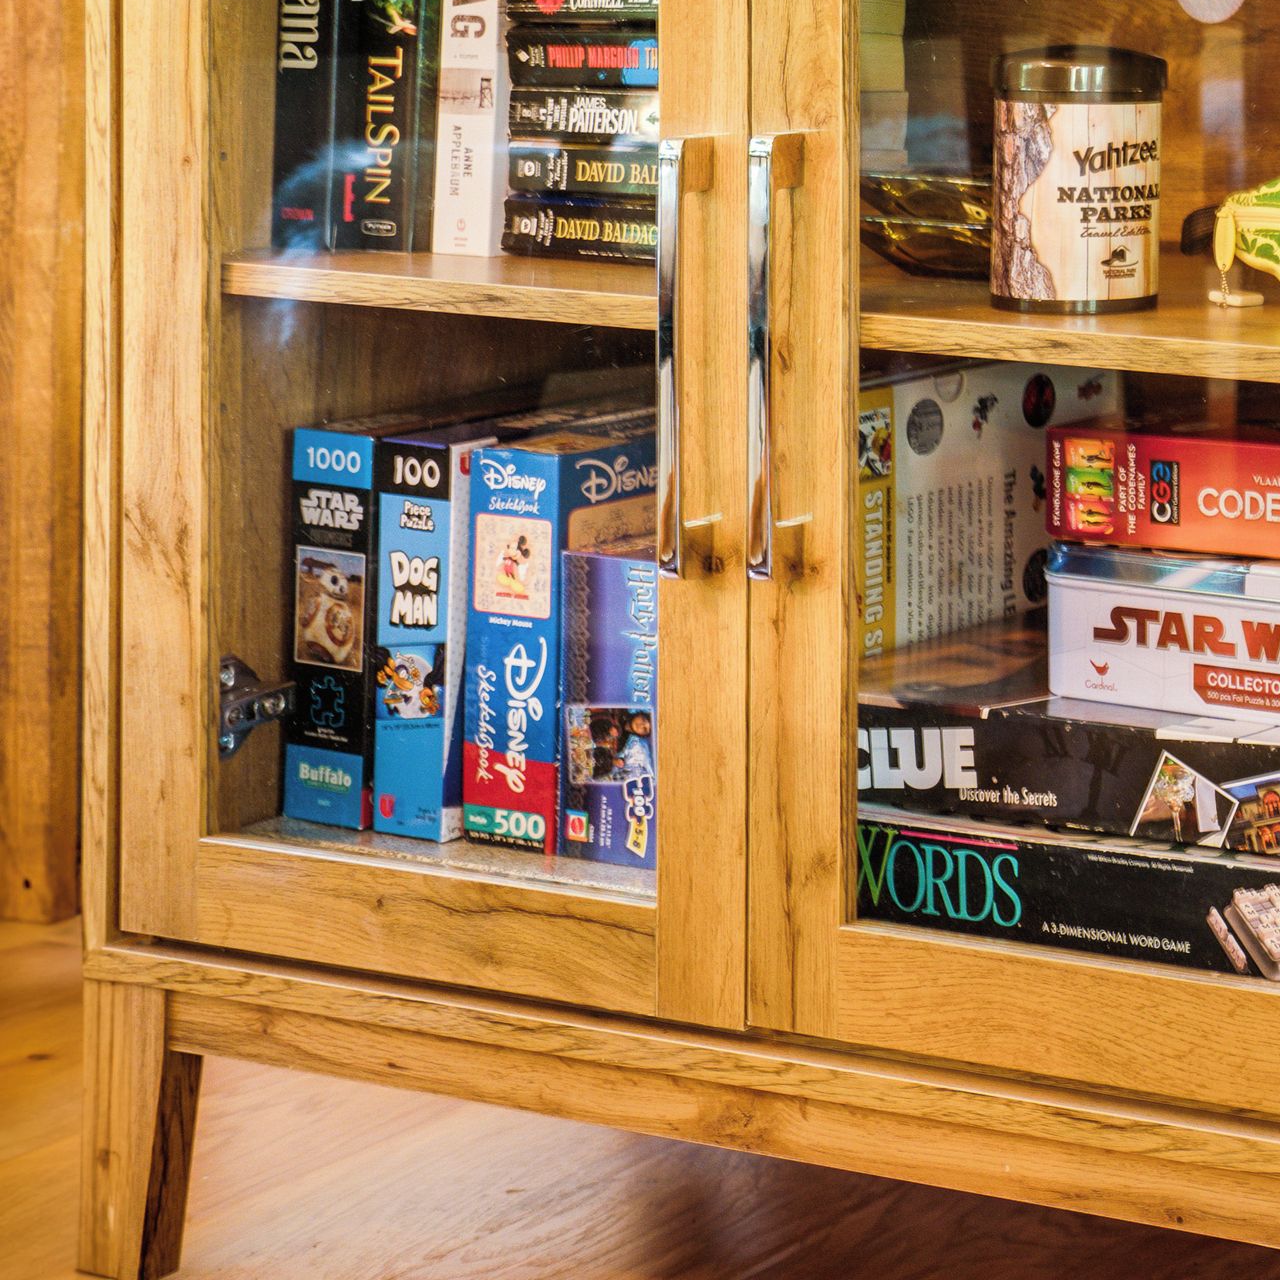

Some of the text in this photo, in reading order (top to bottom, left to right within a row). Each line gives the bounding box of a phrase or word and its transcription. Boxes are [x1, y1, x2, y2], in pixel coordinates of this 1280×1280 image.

[573, 96, 607, 109] JAMES
[364, 45, 404, 205] TAILSPIN
[448, 124, 462, 197] APPLEBAUM
[462, 146, 474, 179] ANNE
[1072, 139, 1159, 177] Yahtzee
[1056, 183, 1160, 204] NATIONAL
[1080, 204, 1153, 224] PARKS
[1080, 226, 1120, 239] Travel
[306, 445, 362, 474] 1000
[393, 454, 441, 489] 100
[1052, 439, 1062, 528] STANDALONE GAME
[1118, 465, 1127, 513] PART OF
[1127, 443, 1138, 536] THE CODENAMES
[1137, 472, 1147, 510] FAMILY
[488, 616, 534, 629] Mickey Mouse
[1093, 605, 1238, 658] STAR
[1084, 678, 1117, 692] Cardinal
[299, 763, 352, 788] Buffalo
[493, 808, 547, 840] 500
